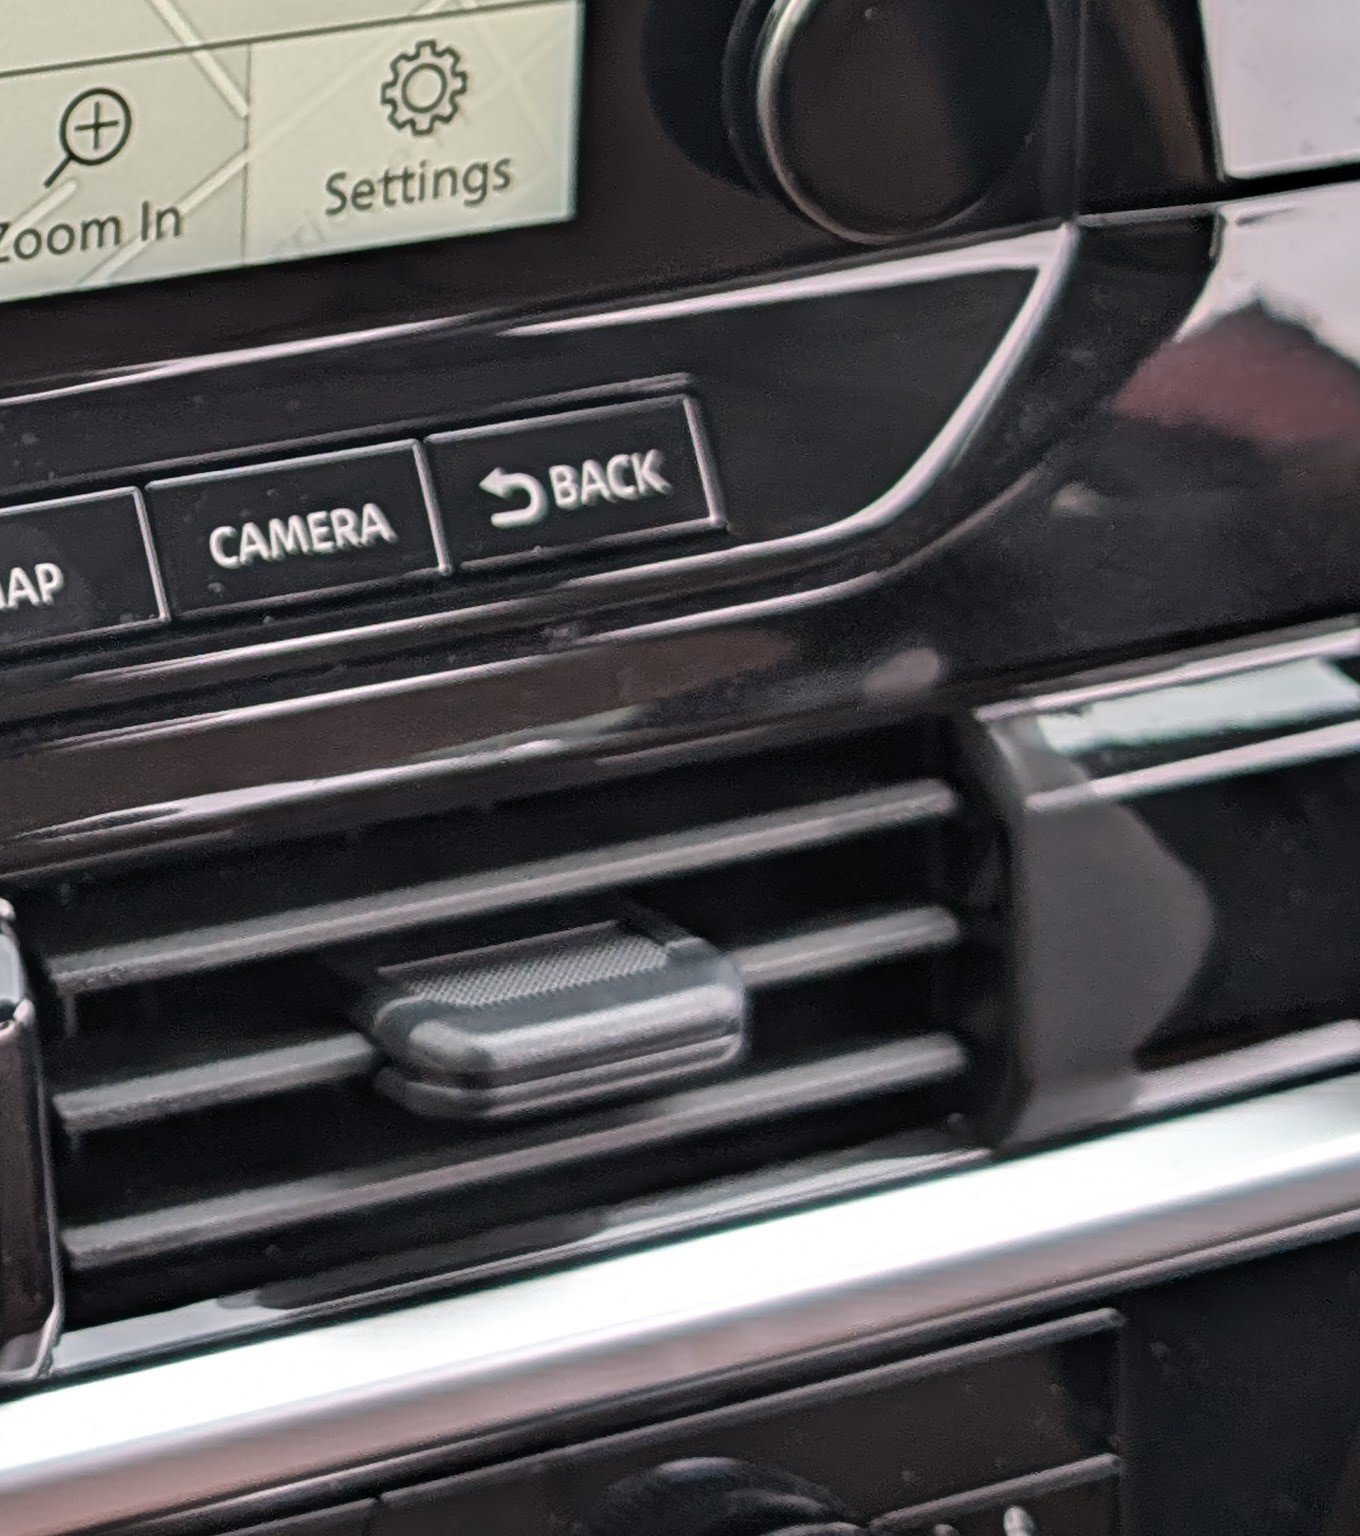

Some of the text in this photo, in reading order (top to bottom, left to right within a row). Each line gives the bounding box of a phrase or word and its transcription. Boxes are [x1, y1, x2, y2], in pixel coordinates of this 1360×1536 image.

[323, 154, 513, 217] Settings
[140, 202, 184, 244] In
[549, 448, 673, 511] BACK
[208, 501, 398, 568] CAMERA
